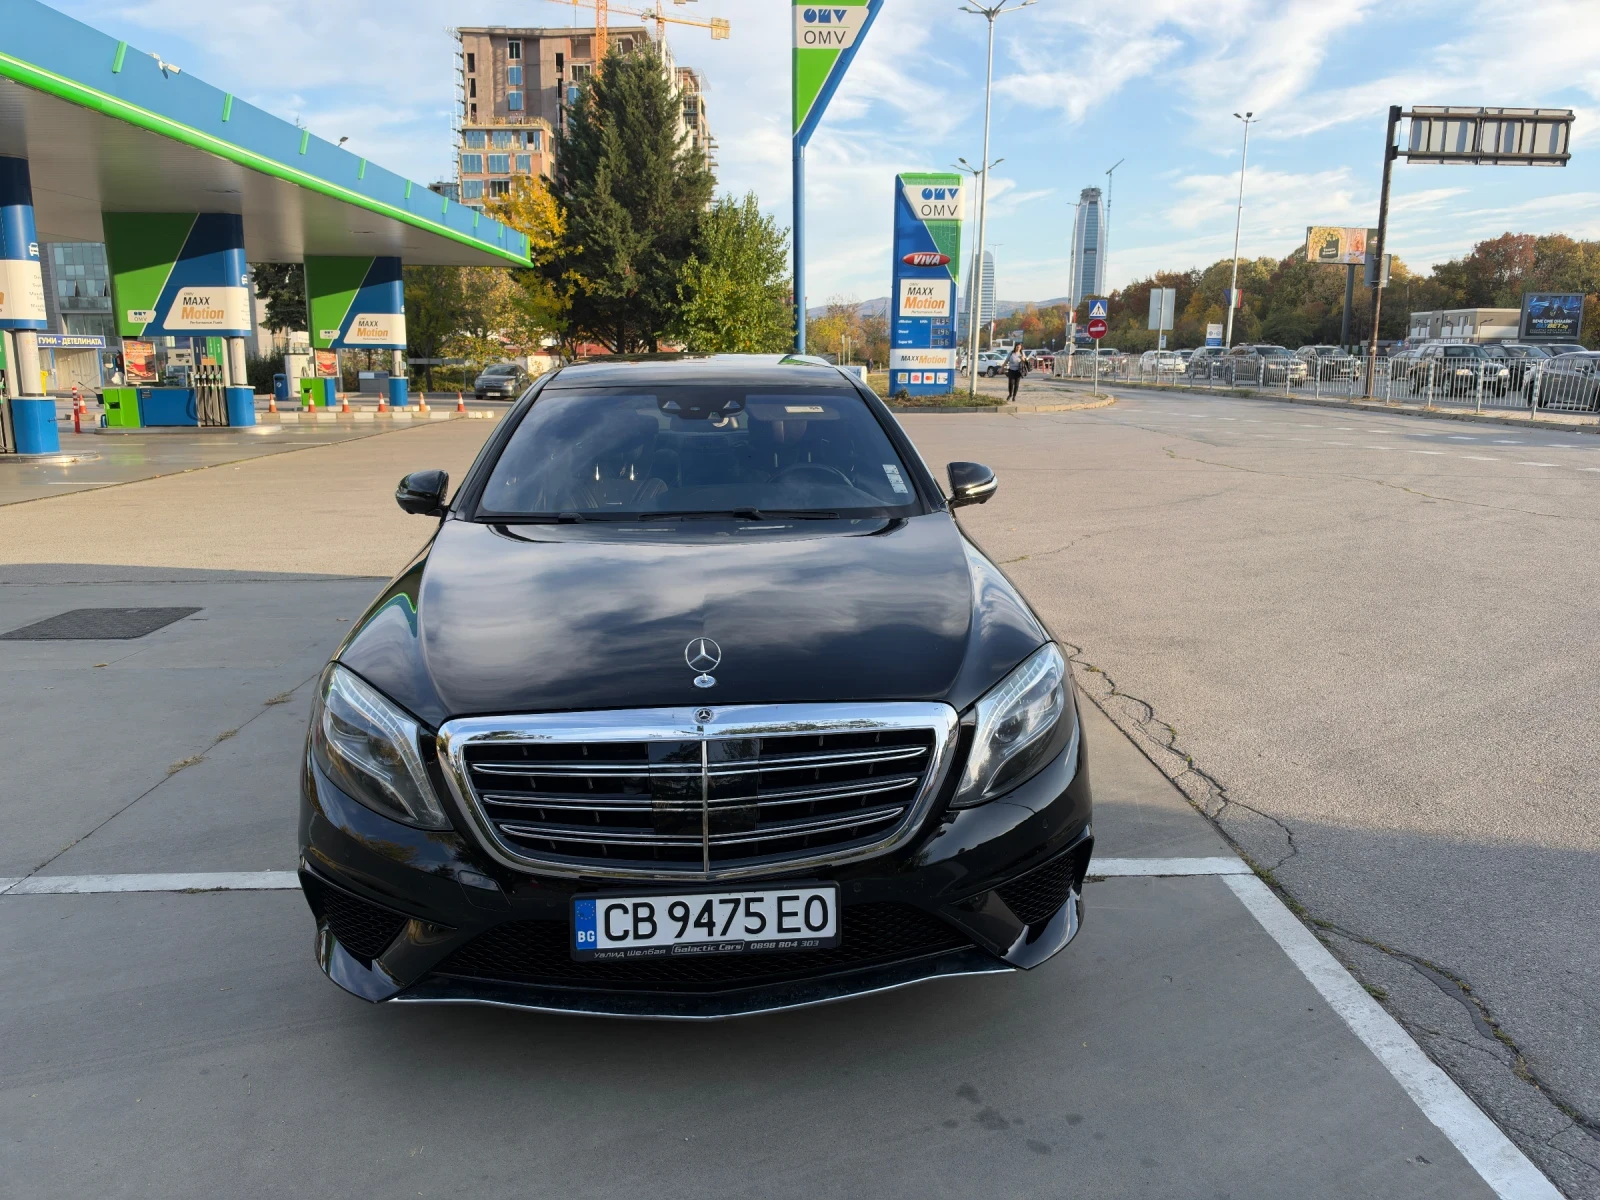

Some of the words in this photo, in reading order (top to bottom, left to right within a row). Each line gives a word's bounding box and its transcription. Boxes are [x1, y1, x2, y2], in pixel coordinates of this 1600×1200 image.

[803, 30, 847, 44] OMV
[921, 204, 958, 216] OMV
[913, 254, 941, 265] VIVA
[907, 287, 934, 296] MAXX
[183, 296, 211, 306] MAXX
[904, 296, 945, 309] Motion
[181, 306, 225, 320] Motion
[357, 327, 389, 337] Motion
[62, 337, 102, 345] ДЕТЕЛИНАТА
[603, 902, 658, 941] CB
[667, 896, 767, 939] 9475
[577, 930, 595, 942] BG
[674, 943, 716, 953] Galactic
[718, 943, 742, 951] Cars
[750, 942, 776, 950] 0898
